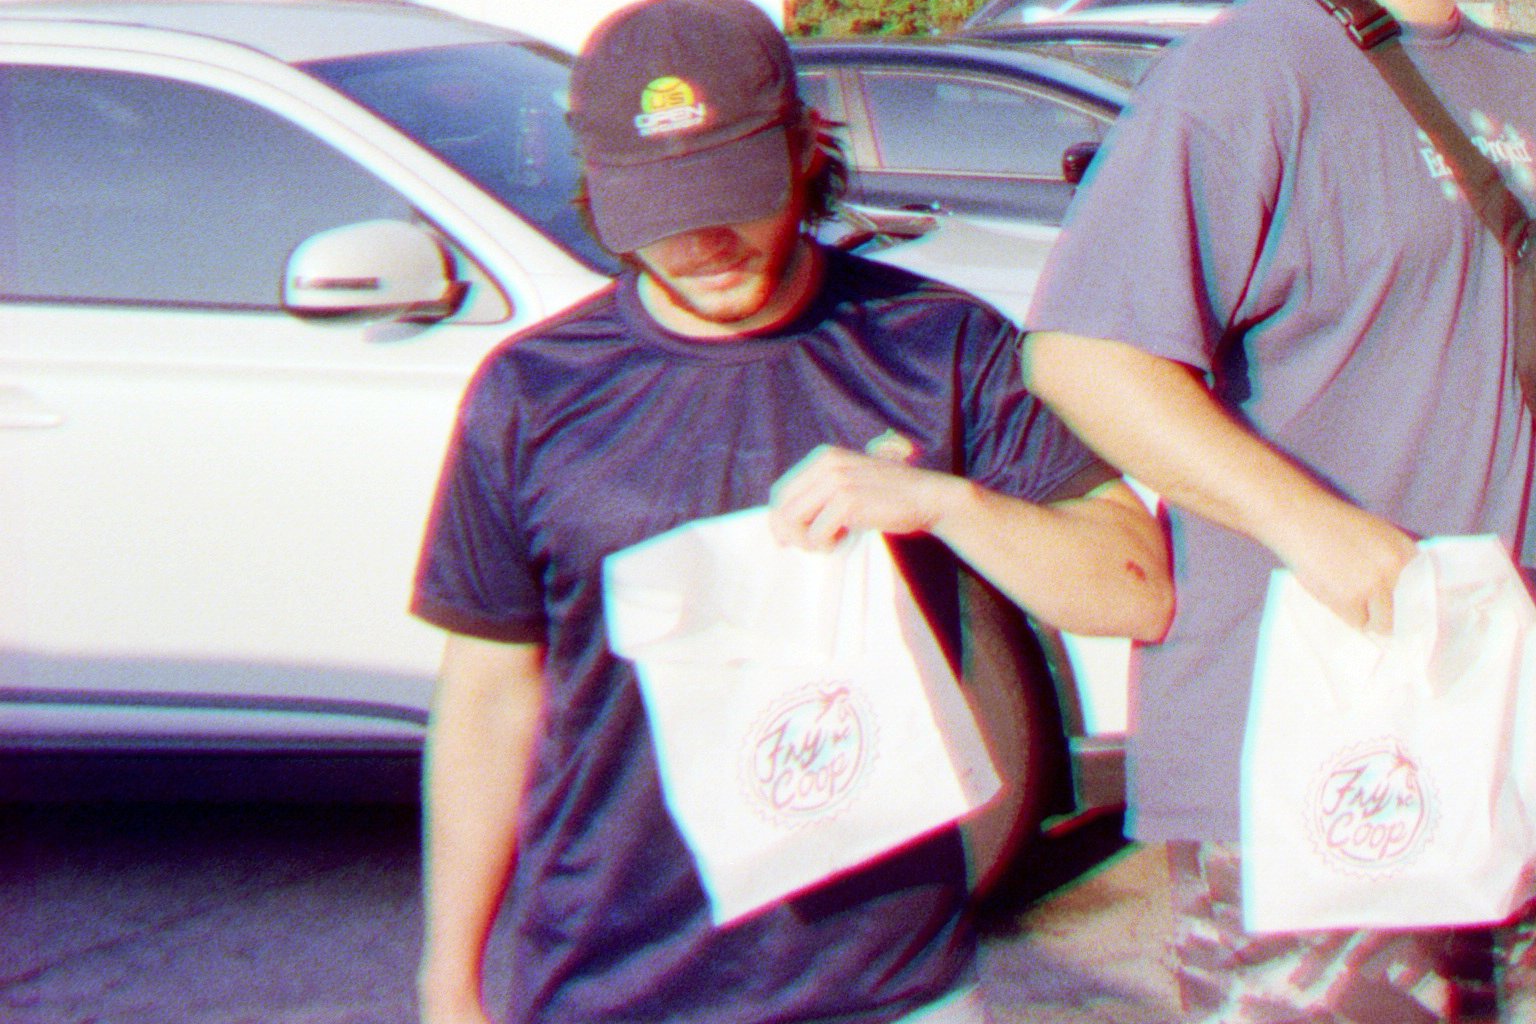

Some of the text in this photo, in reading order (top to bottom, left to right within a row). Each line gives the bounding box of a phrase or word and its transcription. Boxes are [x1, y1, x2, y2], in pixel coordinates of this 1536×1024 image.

[756, 717, 826, 784] Fry
[772, 752, 847, 809] Coop
[1321, 763, 1391, 818] Fry
[1326, 812, 1405, 861] Coop
